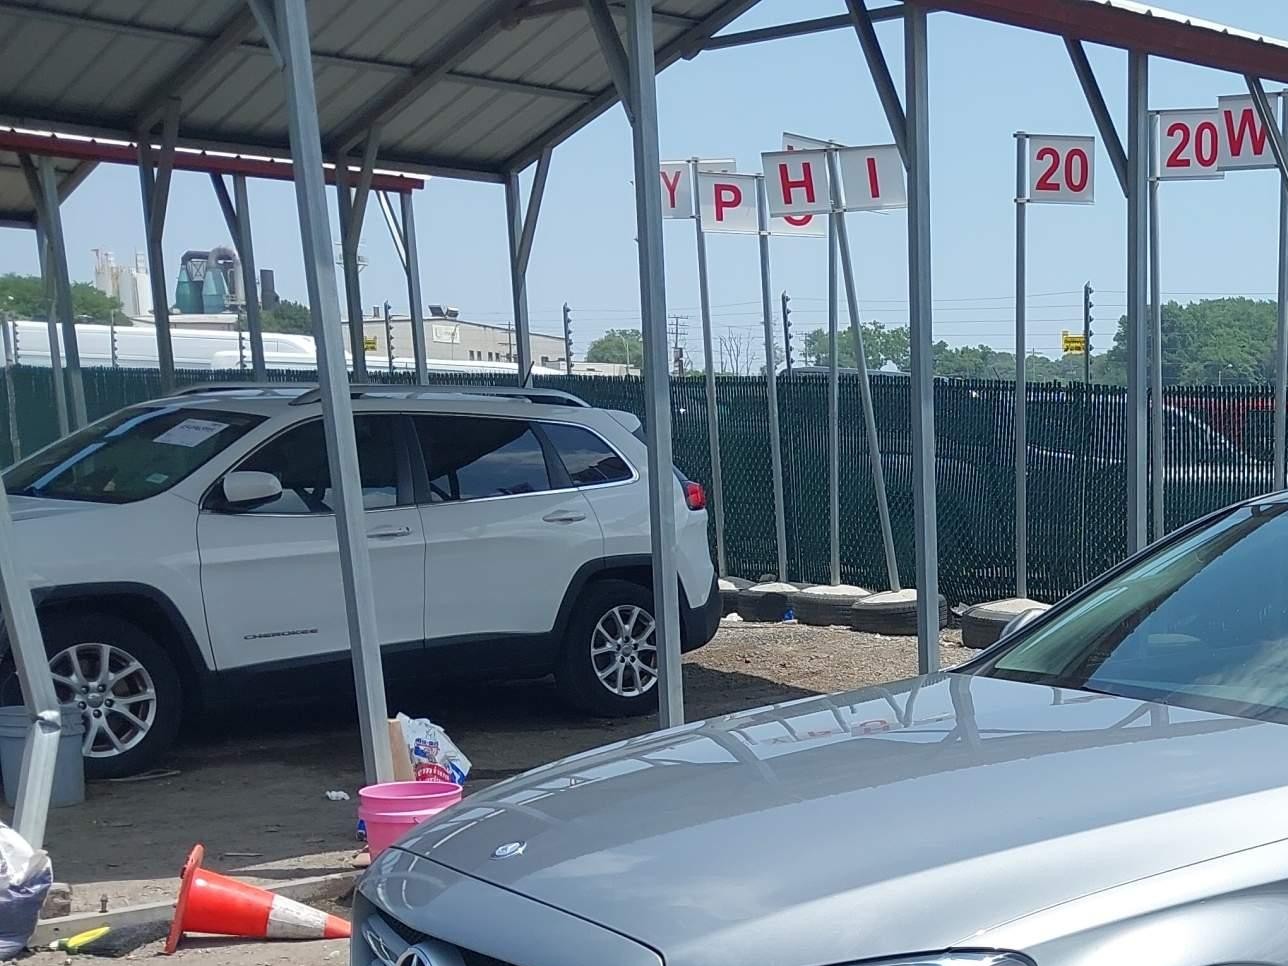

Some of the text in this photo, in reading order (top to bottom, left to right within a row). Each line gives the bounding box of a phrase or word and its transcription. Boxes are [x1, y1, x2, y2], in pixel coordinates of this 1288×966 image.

[1166, 121, 1219, 168] 20
[1223, 108, 1267, 157] W
[660, 170, 682, 209] Y
[778, 162, 816, 205] H
[1035, 147, 1089, 193] 20
[713, 183, 742, 222] P
